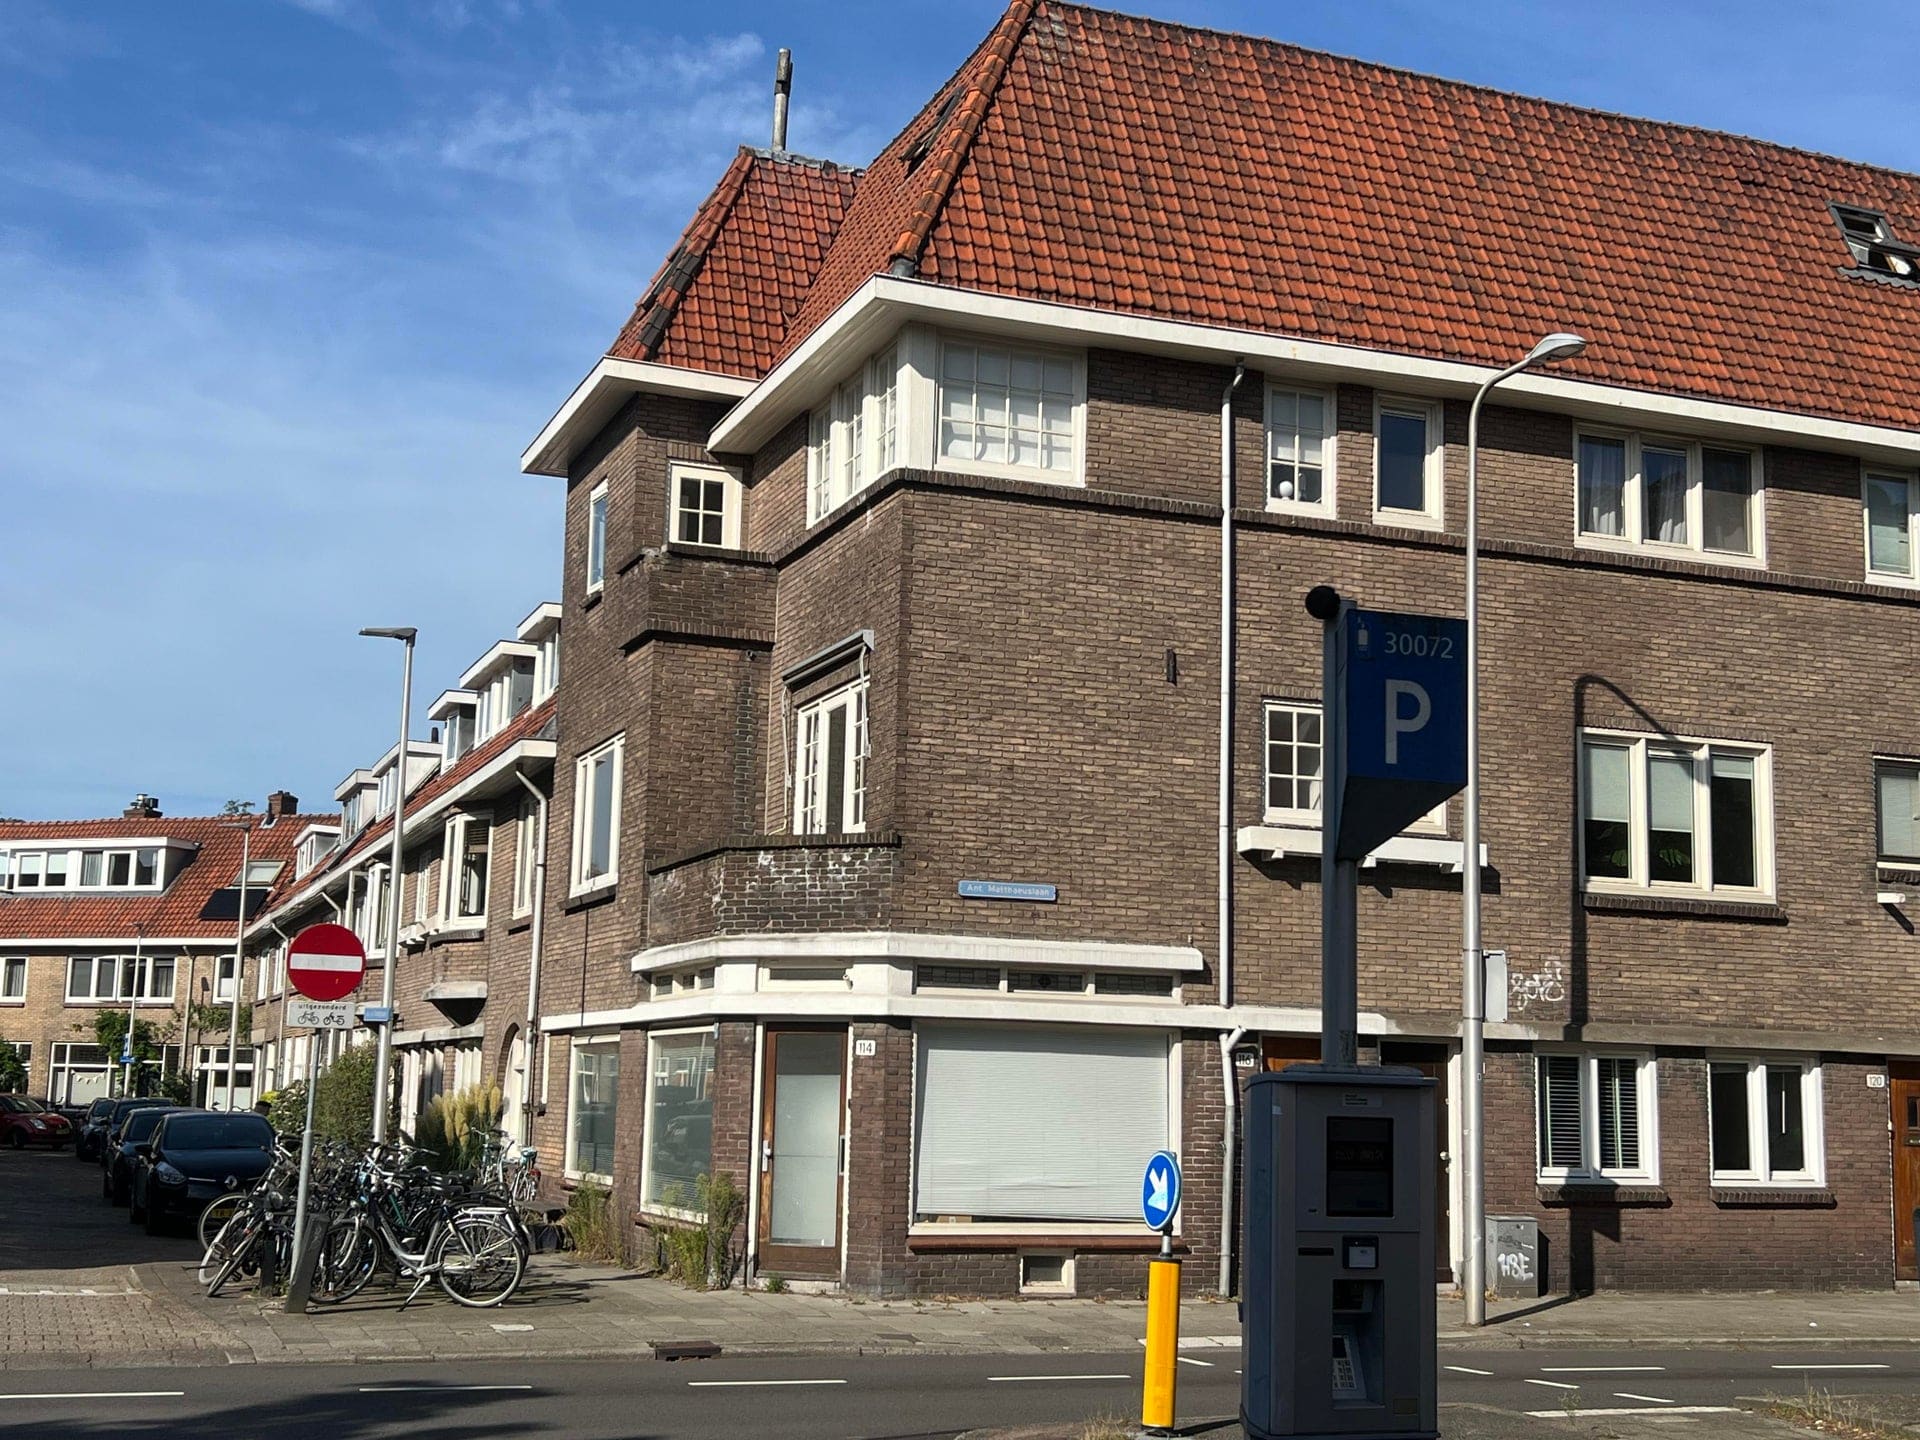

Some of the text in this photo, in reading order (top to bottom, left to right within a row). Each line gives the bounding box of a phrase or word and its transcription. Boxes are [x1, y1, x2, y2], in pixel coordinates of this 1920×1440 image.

[1384, 631, 1454, 660] 30072
[1385, 678, 1432, 765] P
[298, 1003, 347, 1011] uitgezonderd
[859, 1042, 872, 1054] 114
[1238, 1053, 1251, 1065] 116
[1869, 1076, 1882, 1086] 120
